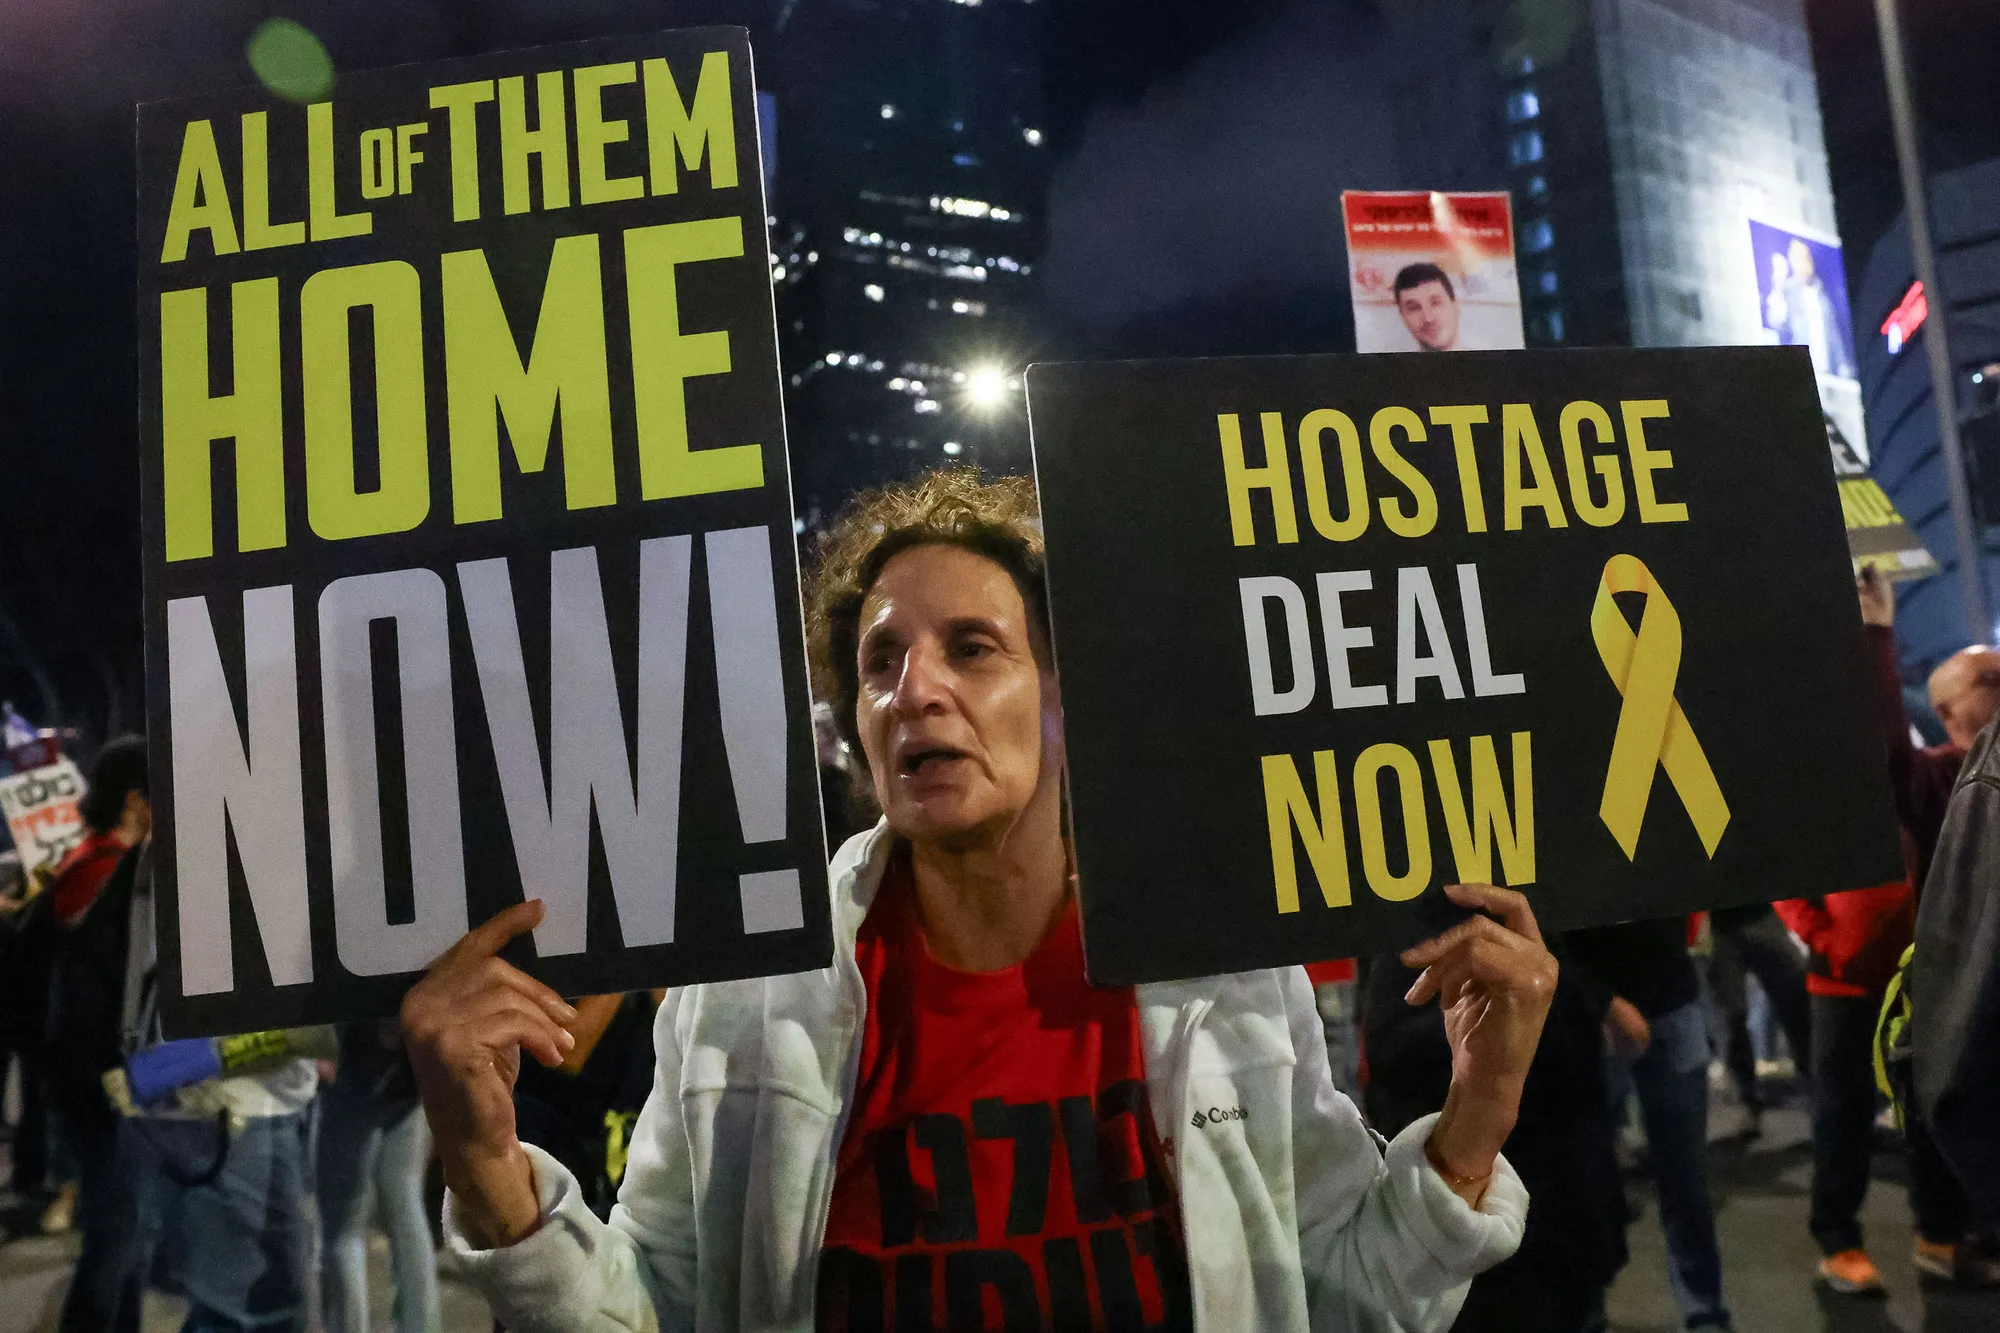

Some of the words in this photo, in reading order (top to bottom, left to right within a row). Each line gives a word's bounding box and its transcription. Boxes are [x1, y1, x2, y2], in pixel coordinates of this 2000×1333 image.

[161, 102, 372, 263] ALL
[360, 122, 428, 199] OF
[430, 52, 738, 222] THEM
[161, 216, 764, 562] HOME
[1218, 399, 1689, 546] HOSTAGE
[1239, 563, 1525, 716] DEAL
[167, 525, 804, 996] NOW!
[1261, 731, 1536, 914] NOW
